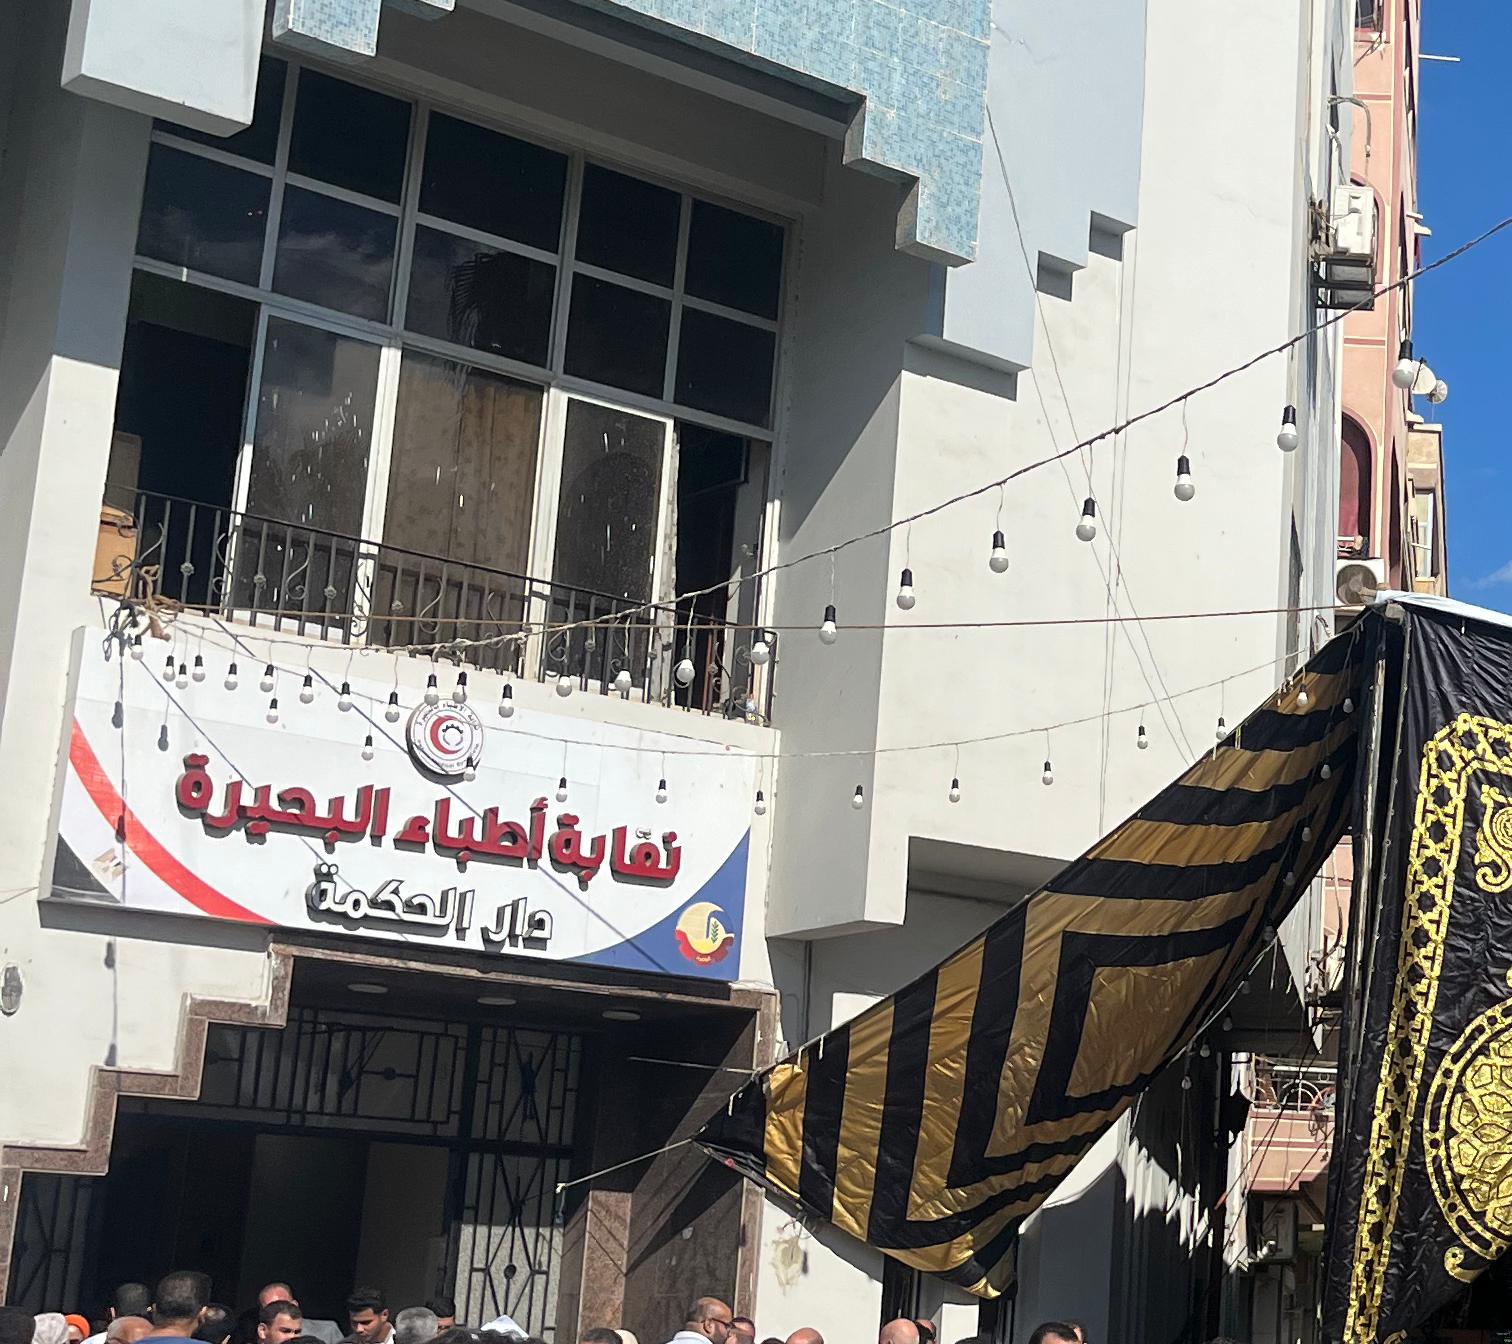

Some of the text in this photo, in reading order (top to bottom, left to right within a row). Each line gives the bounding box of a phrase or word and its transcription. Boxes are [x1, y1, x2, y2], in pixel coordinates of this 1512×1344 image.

[177, 752, 683, 882] نقابة أطباء البحيرة
[305, 862, 554, 943] دار الحكمة
